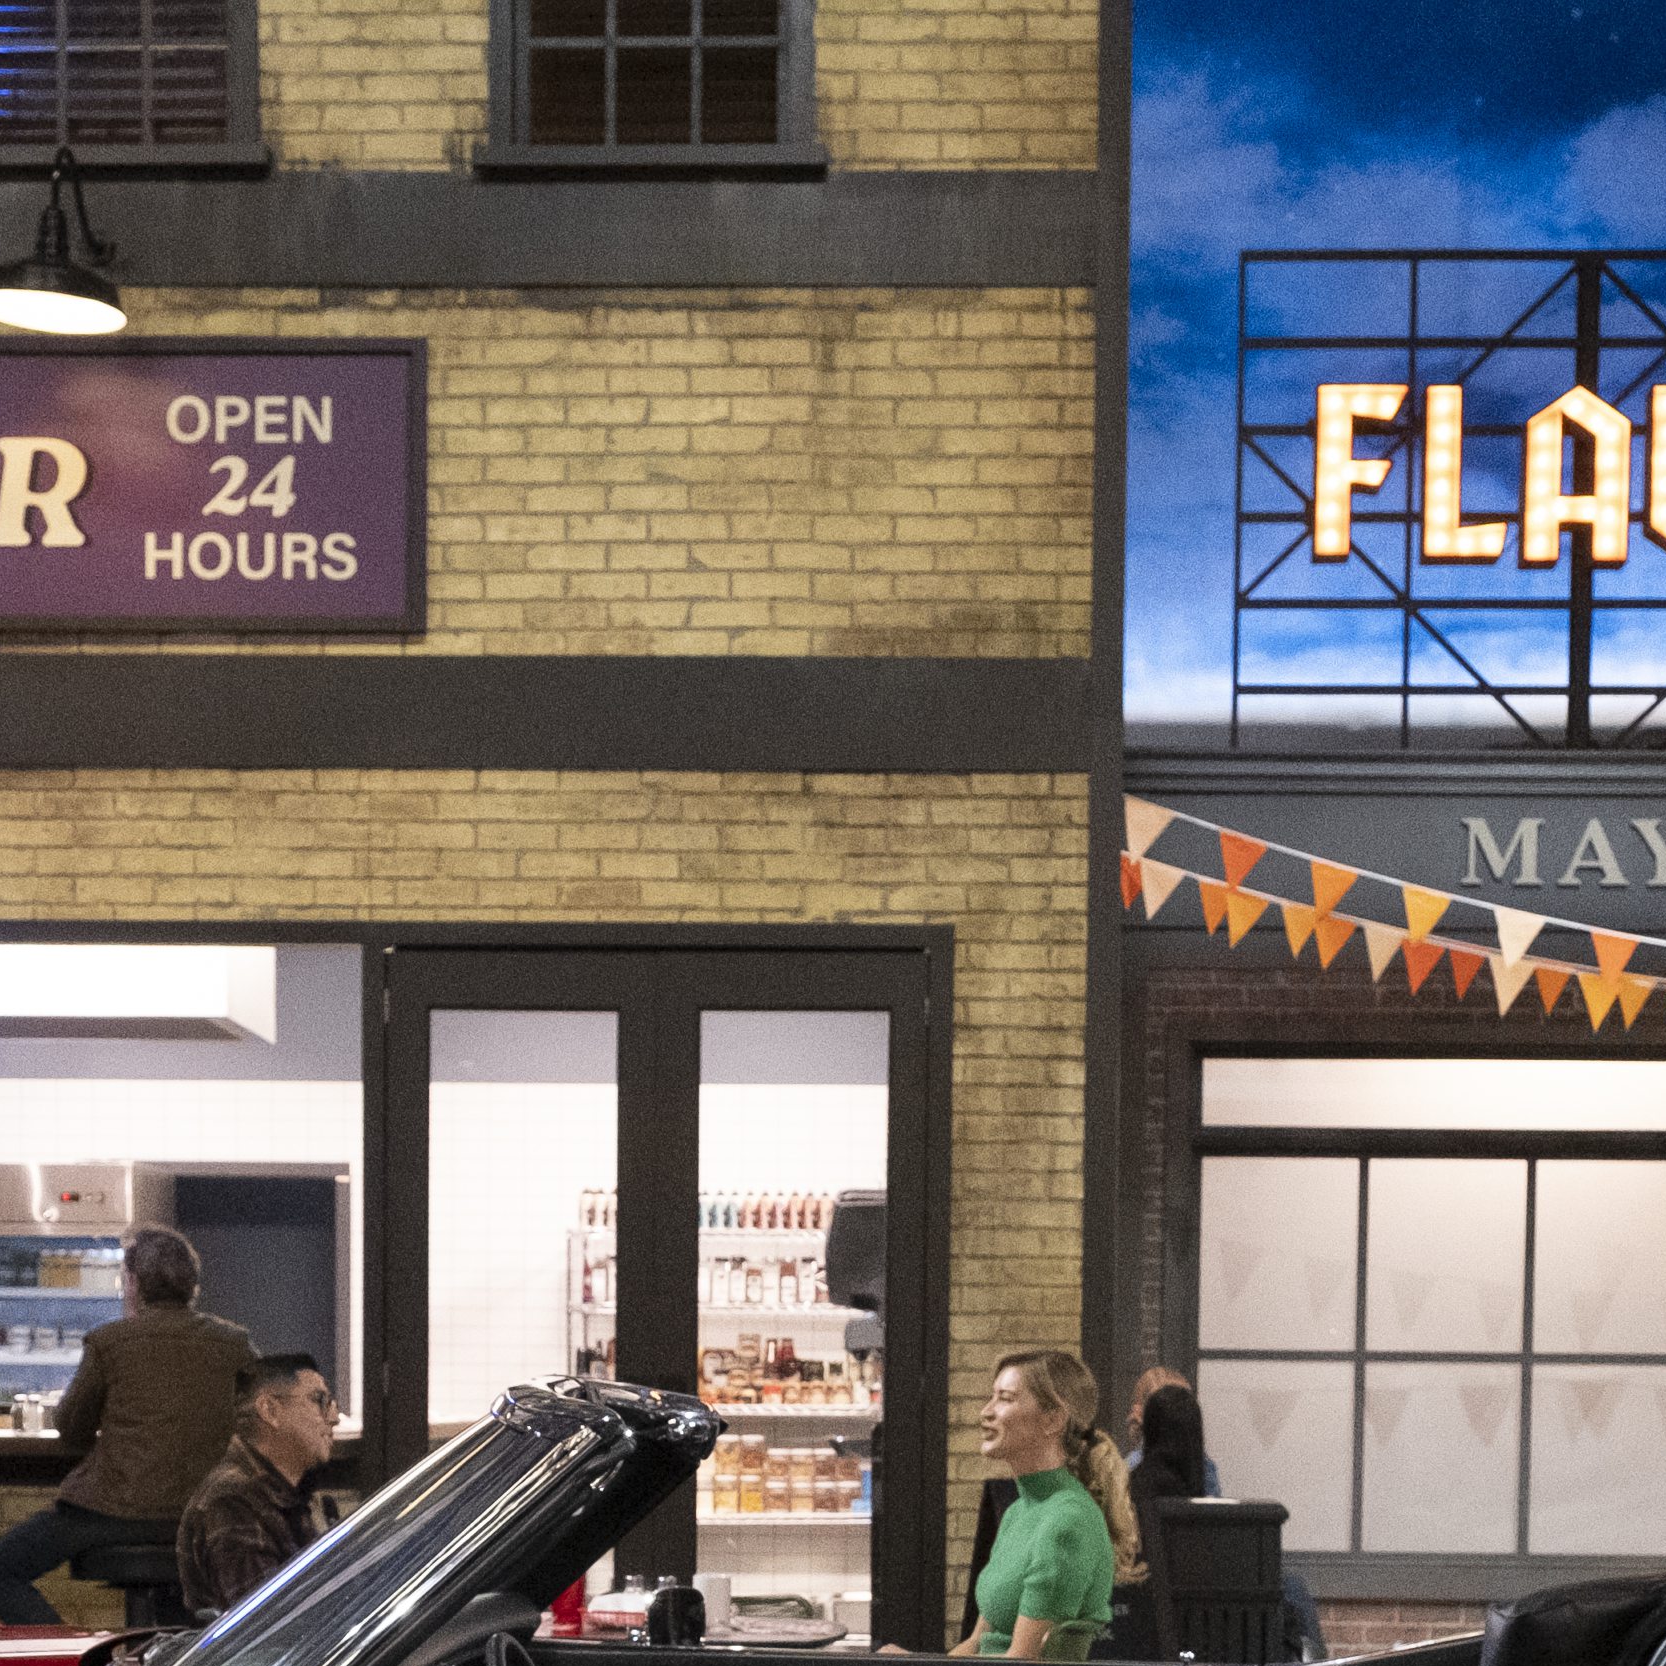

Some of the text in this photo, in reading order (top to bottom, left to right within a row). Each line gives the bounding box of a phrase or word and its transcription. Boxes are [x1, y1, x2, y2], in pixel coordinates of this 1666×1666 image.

[164, 393, 334, 445] OPEN
[200, 455, 297, 519] 24
[142, 529, 359, 582] HOURS
